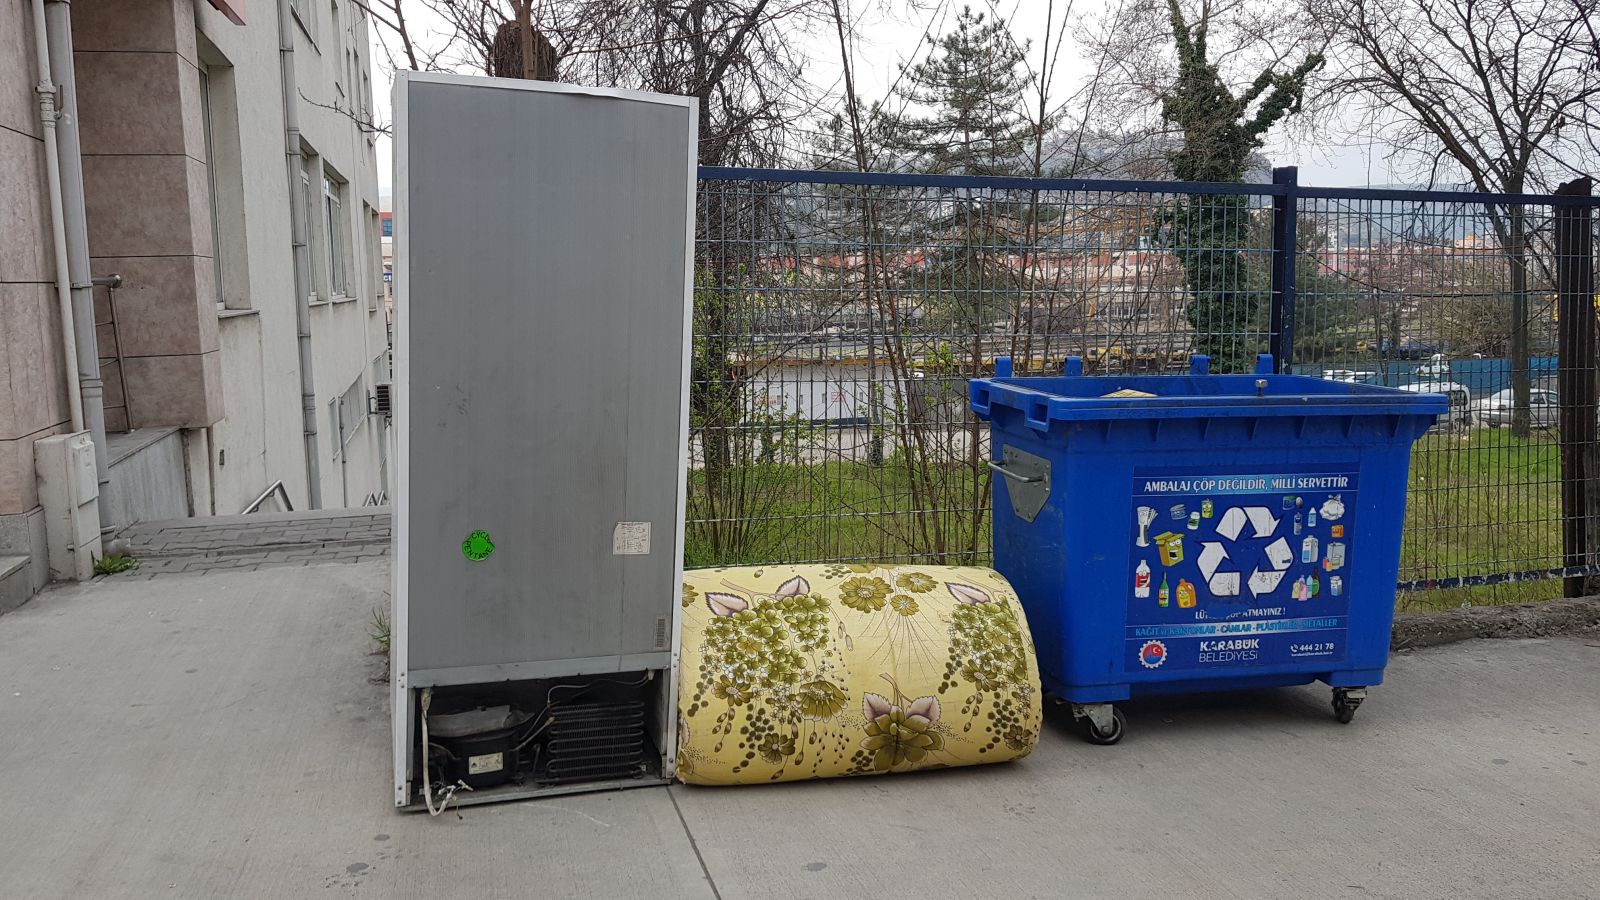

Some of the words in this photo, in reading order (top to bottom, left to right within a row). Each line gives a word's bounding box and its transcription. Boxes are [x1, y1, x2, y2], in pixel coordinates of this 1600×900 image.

[1144, 480, 1190, 492] AMBALAJ
[1193, 477, 1215, 493] ÇÖP
[1218, 476, 1268, 491] DEĞİLDİR,
[1271, 475, 1295, 489] MİLLİ
[1298, 474, 1348, 489] SERVETTİR
[1200, 639, 1260, 652] KARABÜK
[1299, 643, 1313, 651] 444
[1325, 642, 1335, 650] 78
[1199, 650, 1258, 662] BELEDİYESİ
